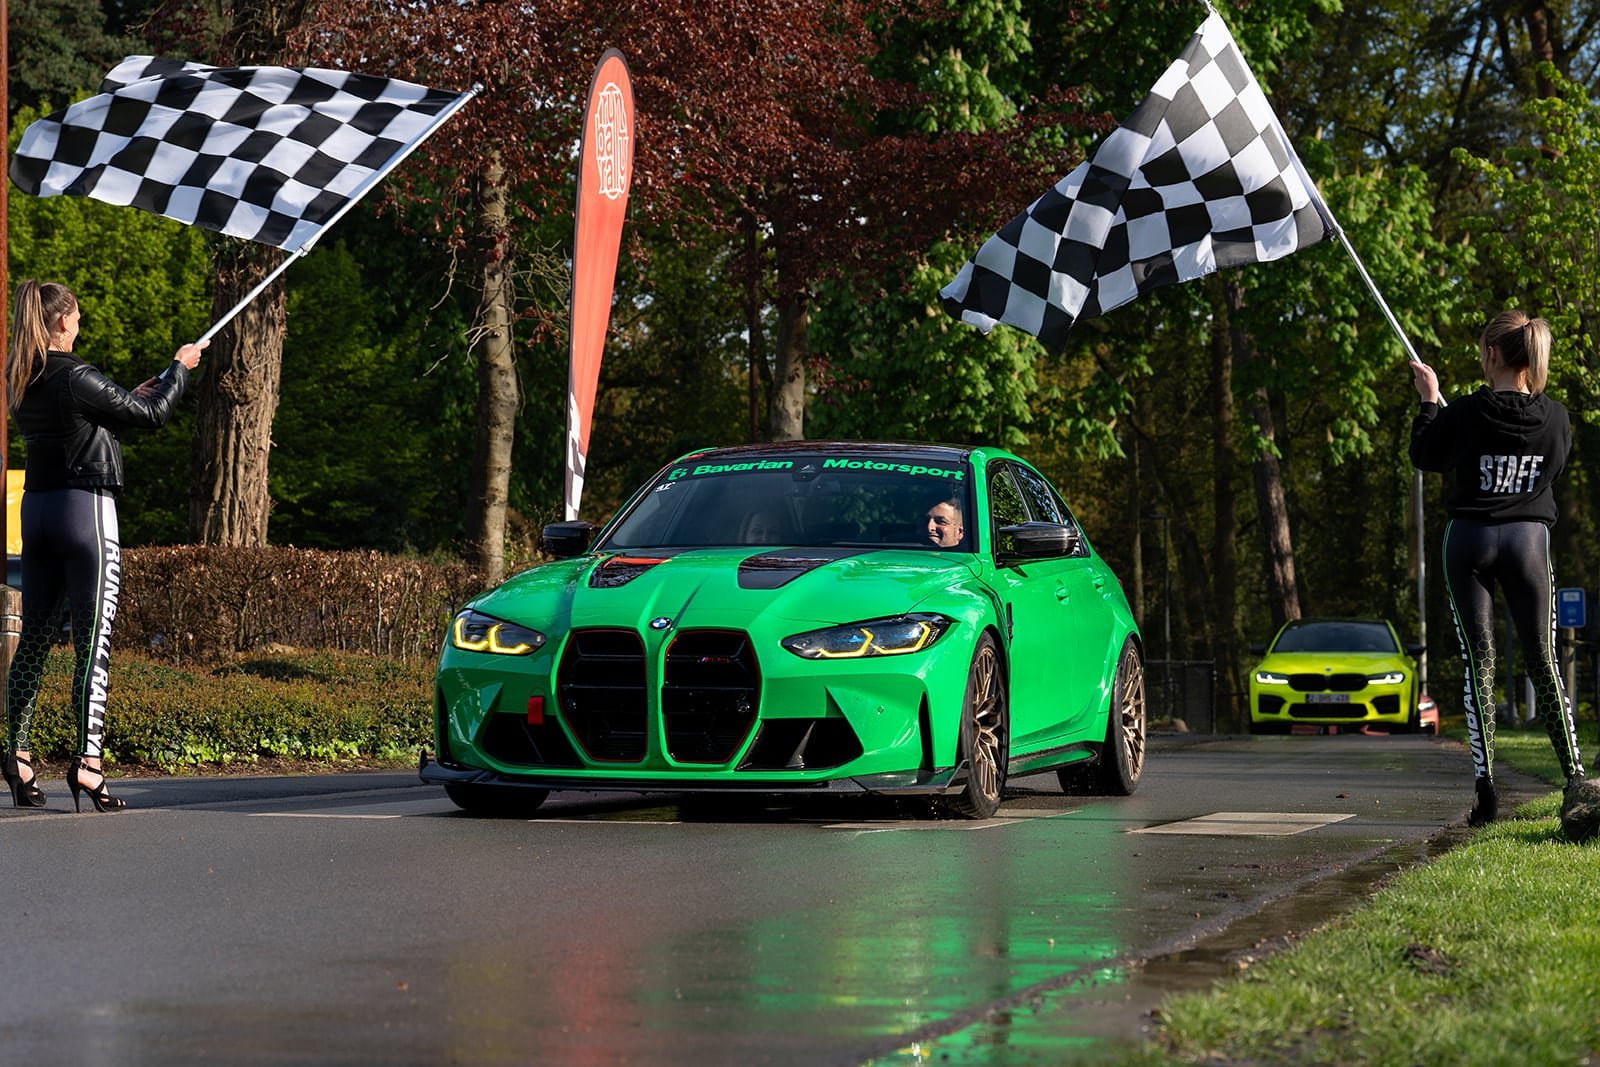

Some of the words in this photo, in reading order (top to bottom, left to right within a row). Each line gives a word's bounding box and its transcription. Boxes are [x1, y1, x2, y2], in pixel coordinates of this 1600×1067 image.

[692, 460, 793, 475] Bavarian
[822, 459, 964, 480] Motorsport
[1480, 455, 1544, 493] STAFF
[97, 541, 120, 661] RUNBALL
[86, 665, 108, 751] RALLY
